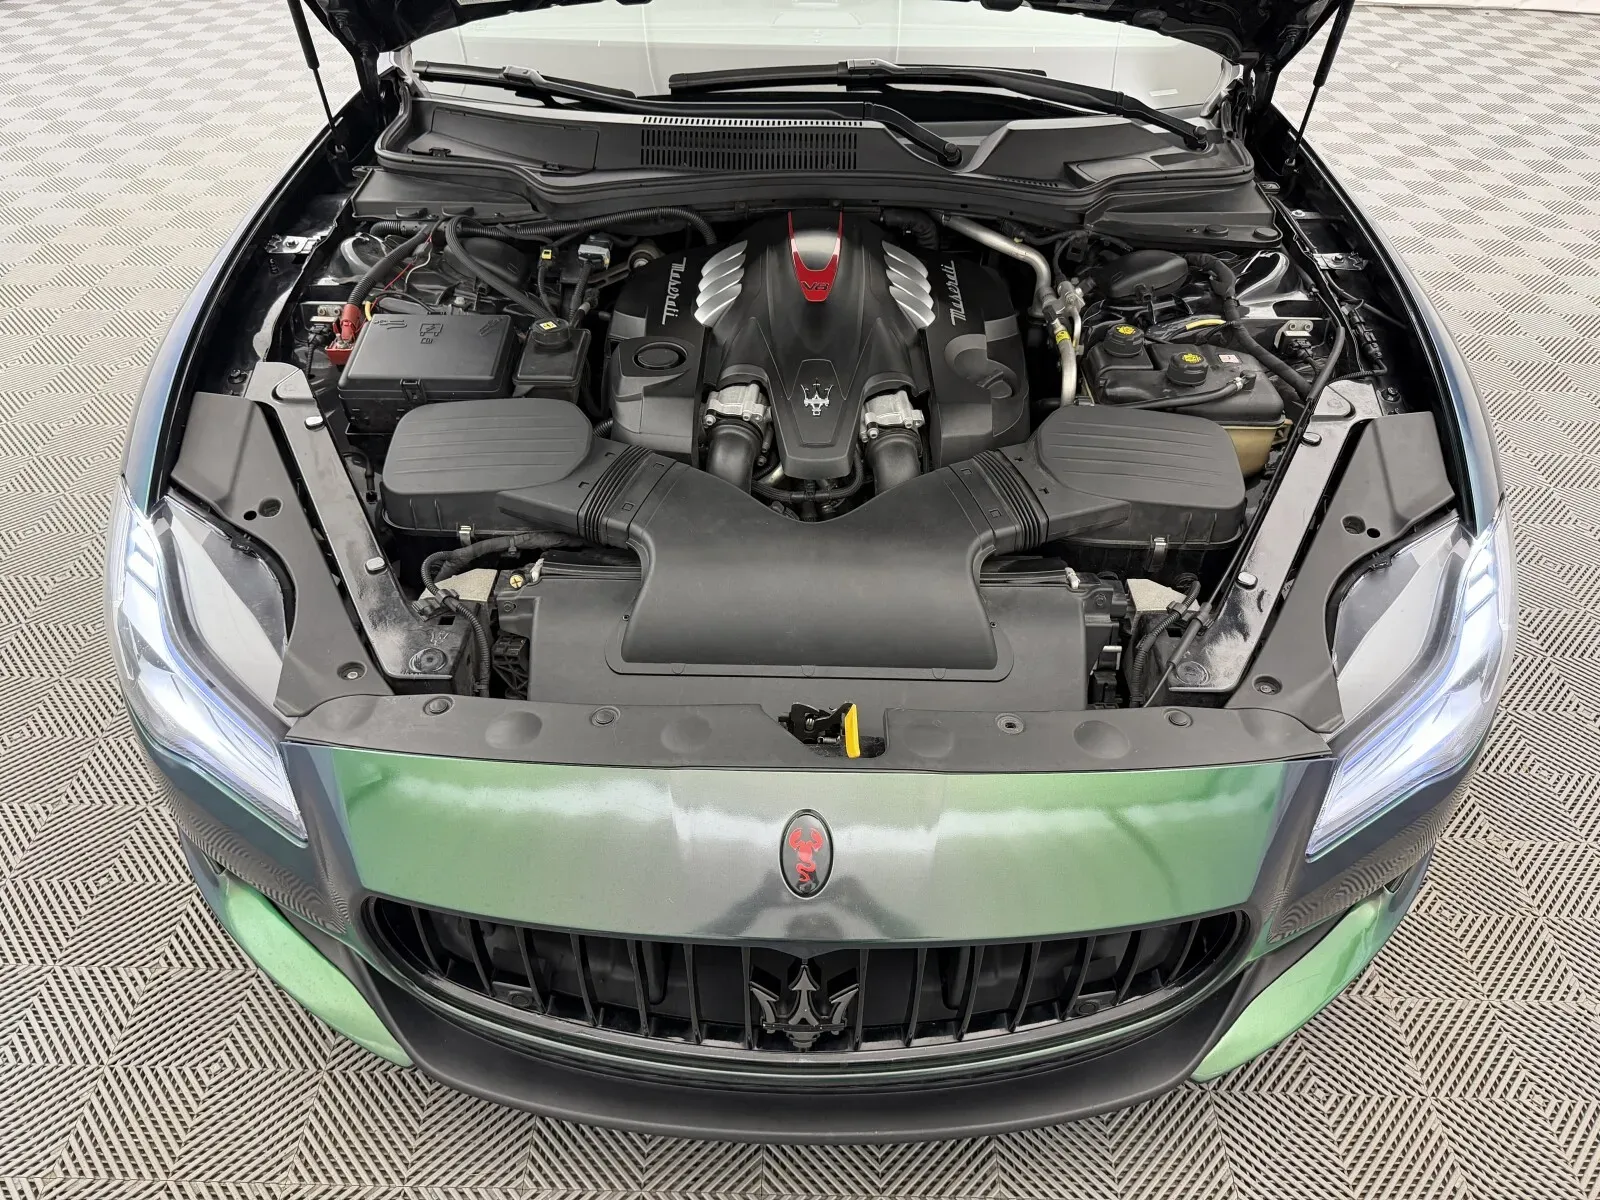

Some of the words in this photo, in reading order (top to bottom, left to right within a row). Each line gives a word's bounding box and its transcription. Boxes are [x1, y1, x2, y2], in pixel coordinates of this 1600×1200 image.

[662, 257, 687, 325] Maserati
[800, 281, 829, 290] V8
[940, 260, 967, 326] Maserati
